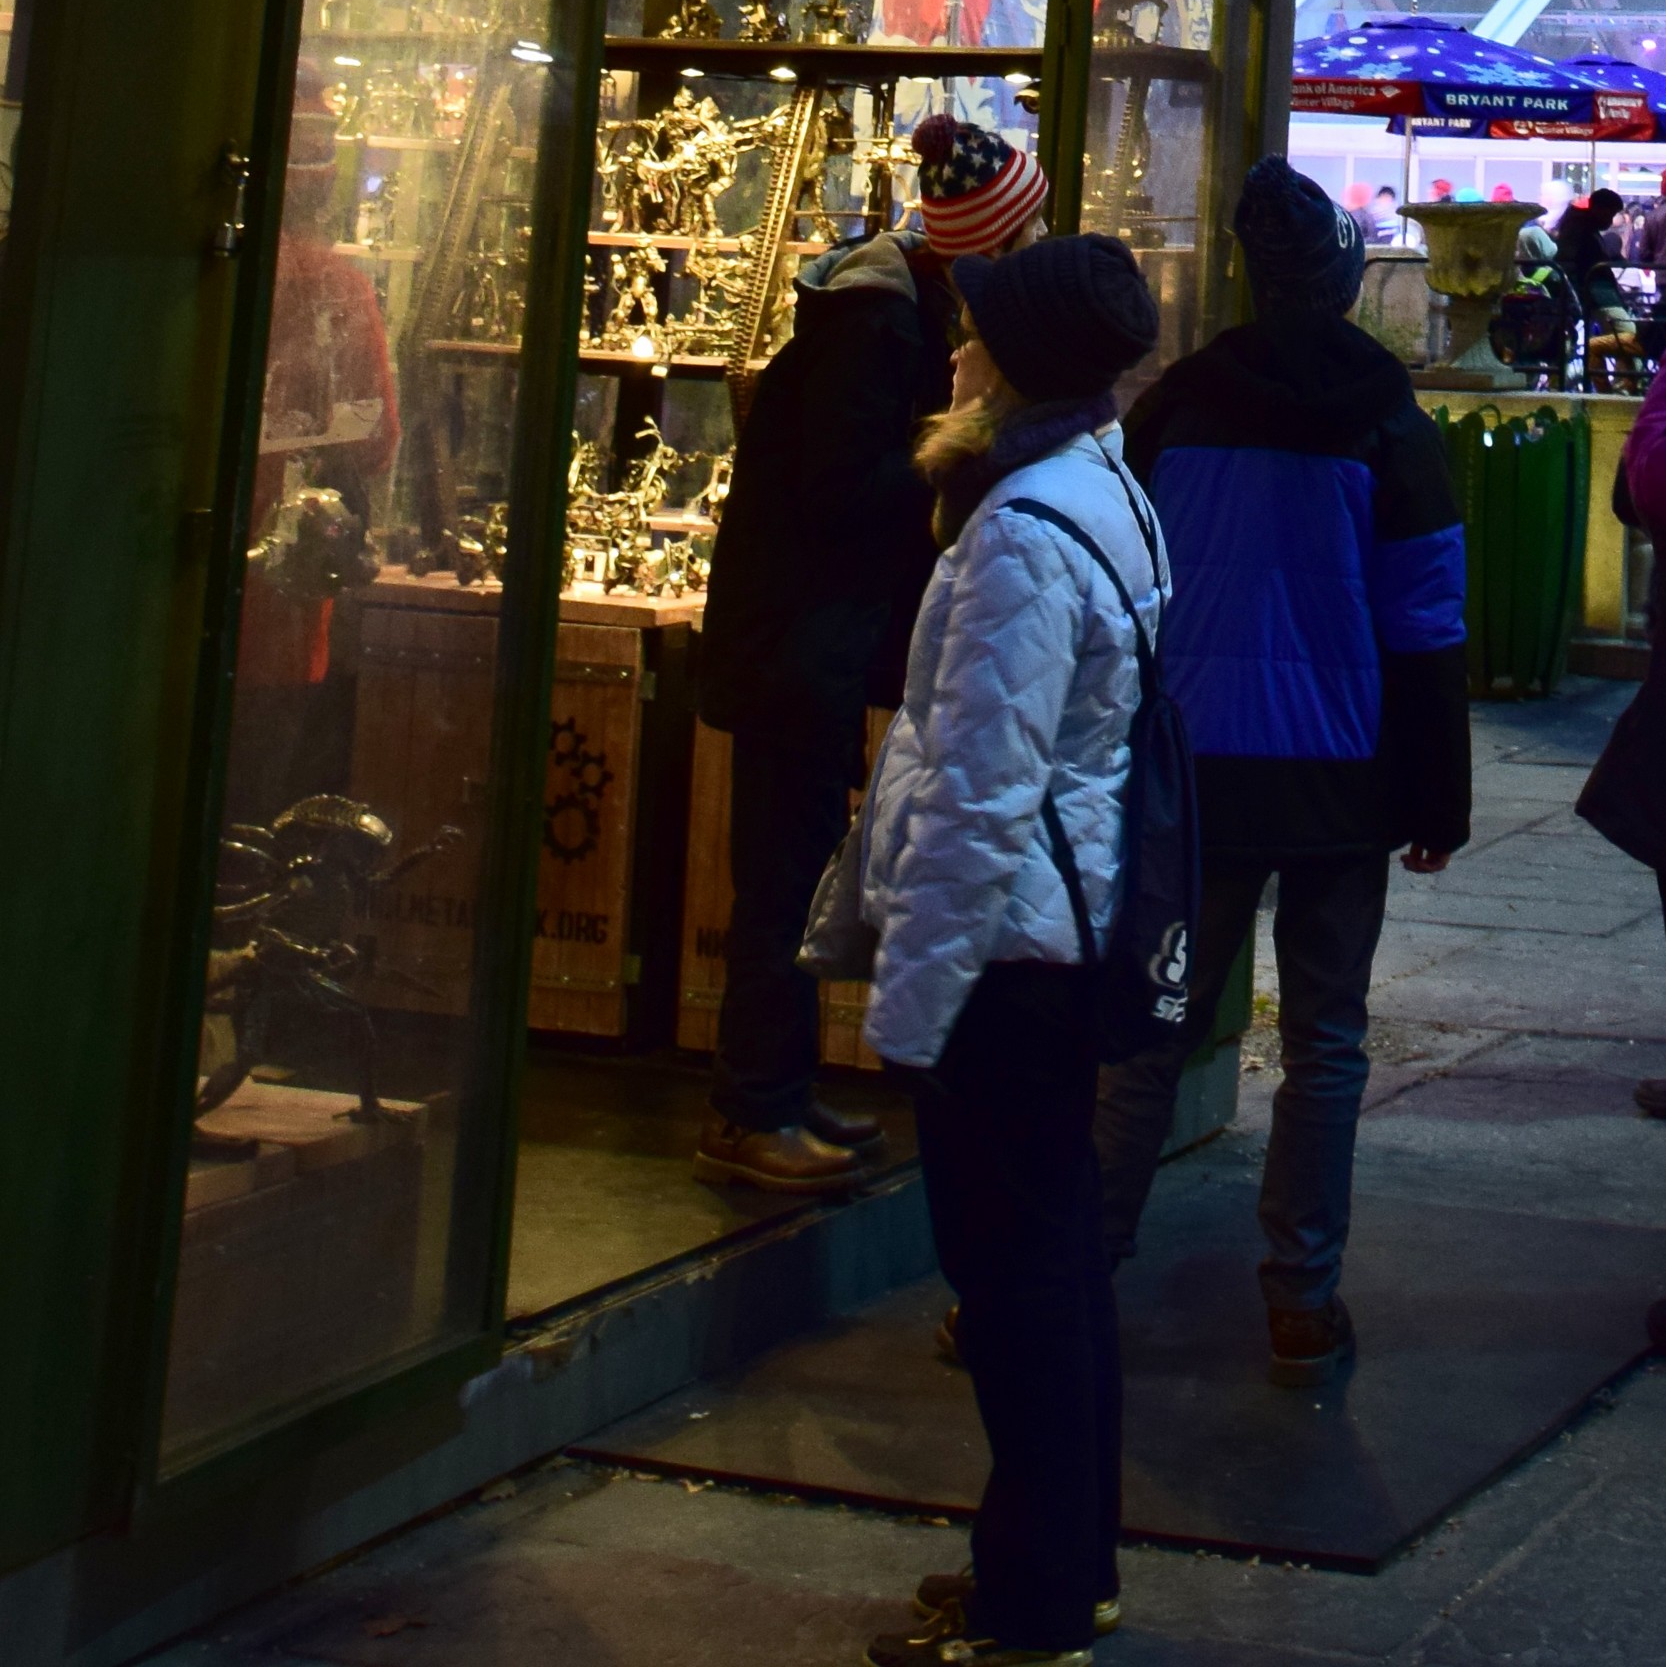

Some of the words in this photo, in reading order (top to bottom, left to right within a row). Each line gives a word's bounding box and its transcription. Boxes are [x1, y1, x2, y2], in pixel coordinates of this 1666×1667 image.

[1317, 82, 1328, 95] of
[1328, 84, 1377, 97] America
[1322, 97, 1356, 110] Village
[1445, 93, 1516, 107] BRYANT
[1523, 97, 1569, 112] PARK
